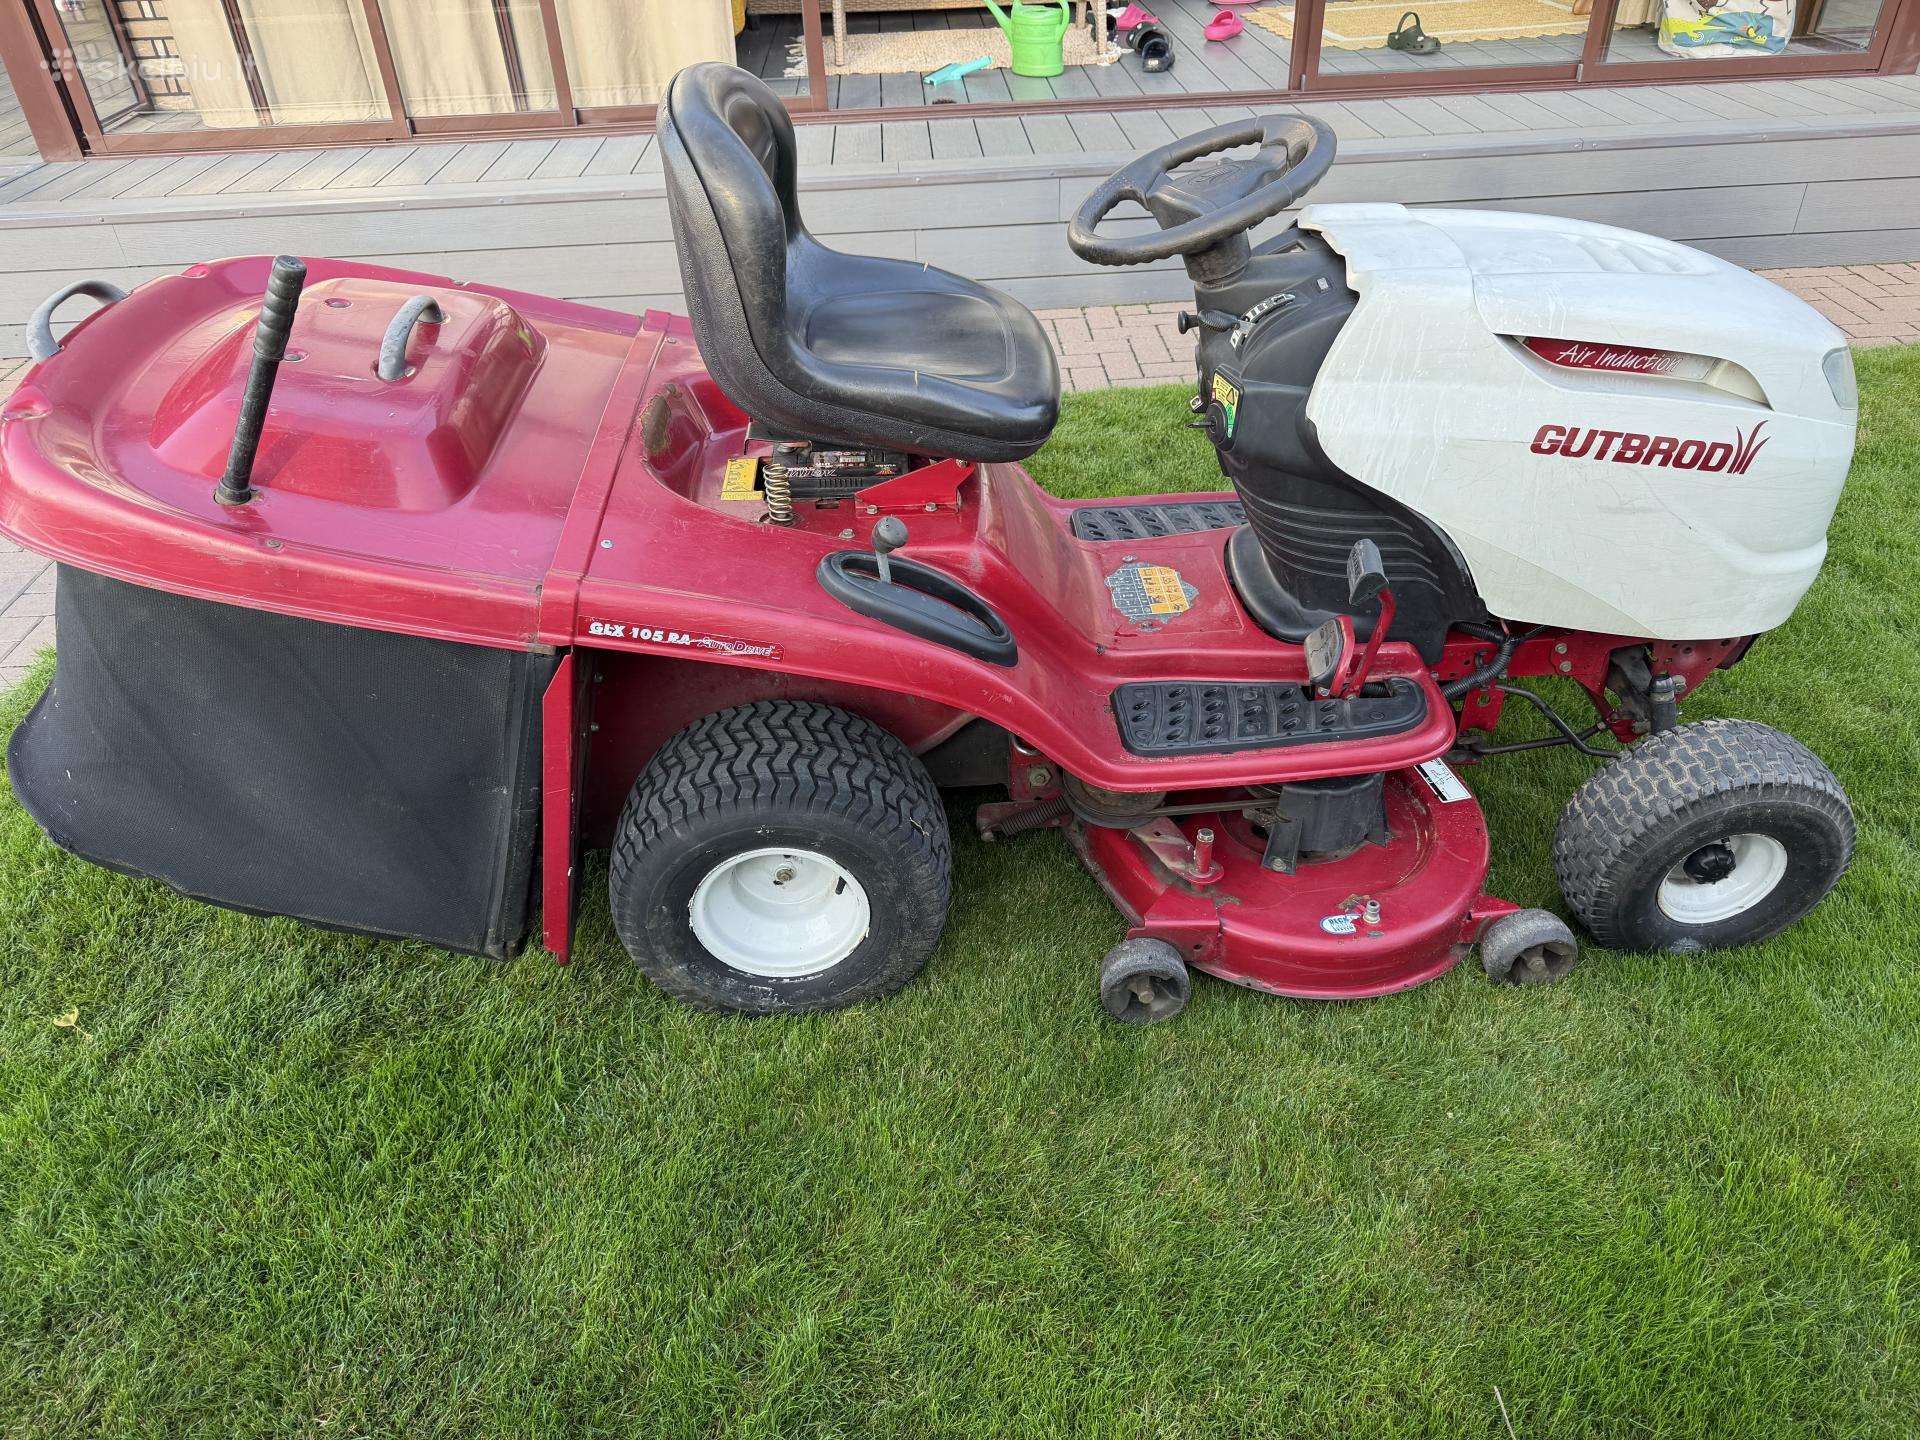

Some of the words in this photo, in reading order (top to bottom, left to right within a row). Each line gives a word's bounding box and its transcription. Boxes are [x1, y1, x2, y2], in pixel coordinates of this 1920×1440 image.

[1555, 344, 1594, 364] Air
[1595, 348, 1682, 373] Induction
[1530, 424, 1734, 473] GUTBROD
[589, 621, 625, 638] GLX
[630, 627, 664, 642] 105
